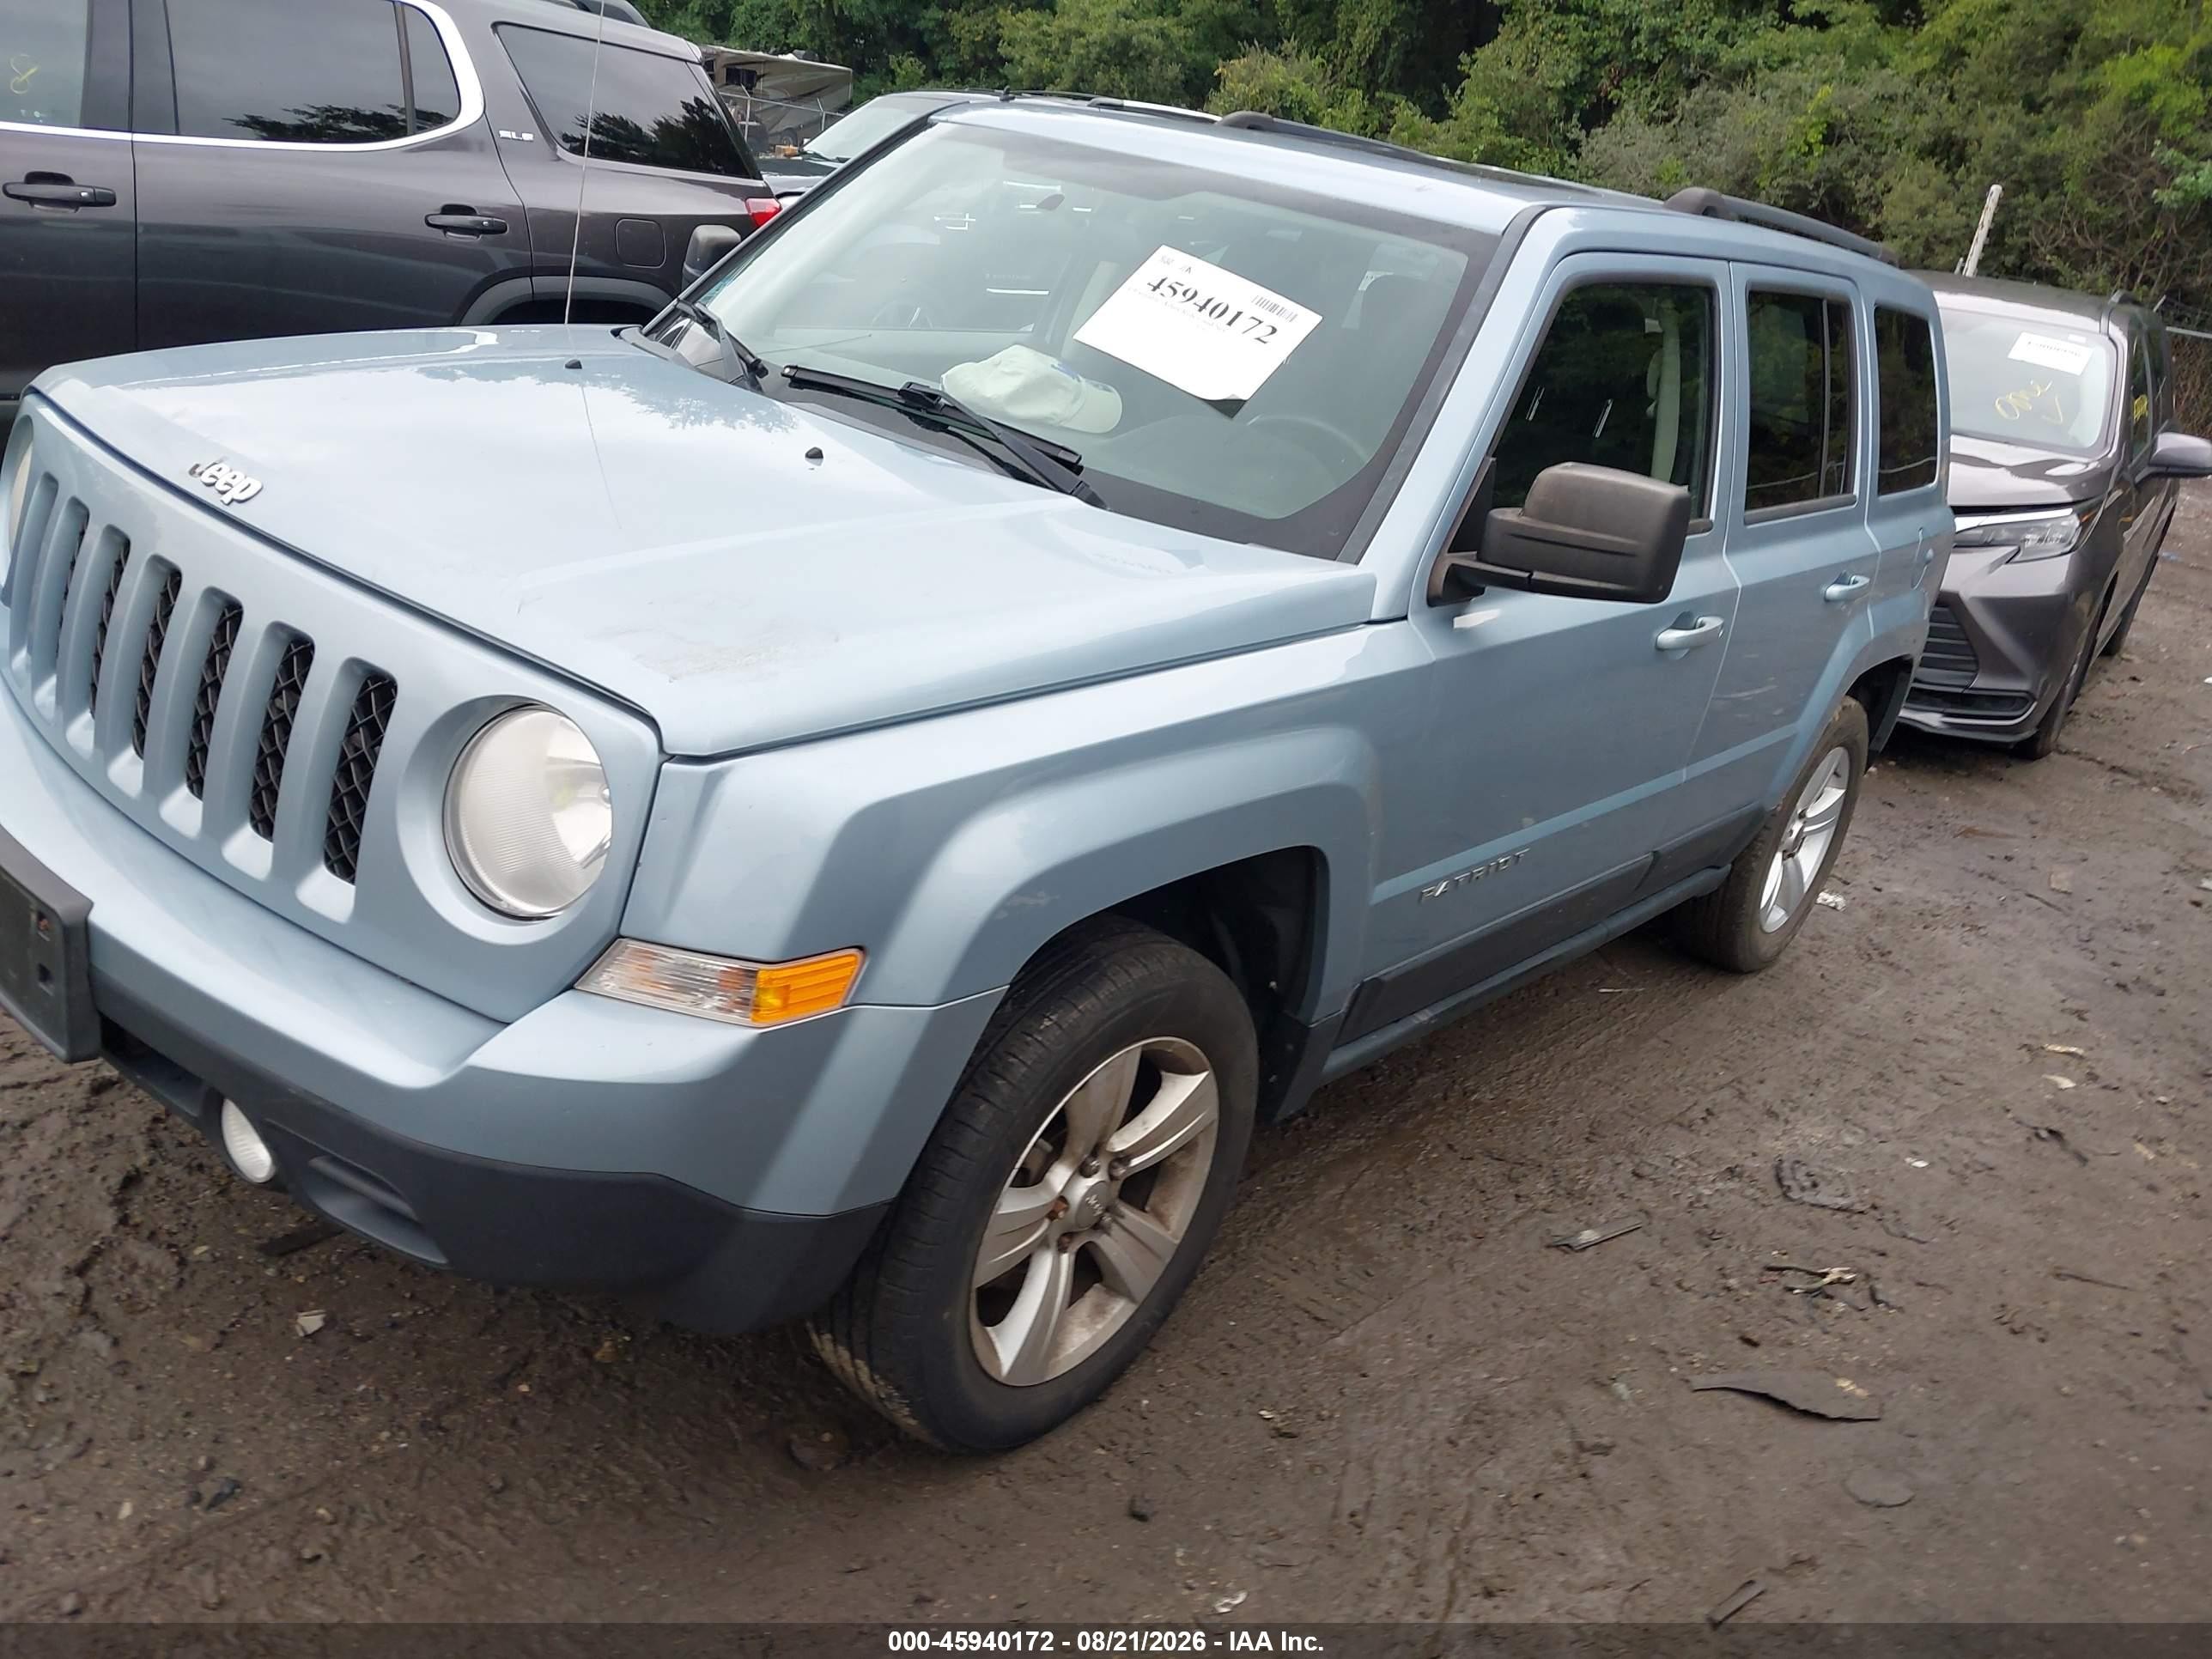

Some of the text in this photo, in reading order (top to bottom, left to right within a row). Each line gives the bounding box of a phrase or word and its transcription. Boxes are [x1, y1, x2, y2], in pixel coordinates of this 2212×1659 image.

[1146, 276, 1278, 344] 45940172
[188, 457, 264, 506] Jeep
[1418, 847, 1530, 903] PATRIOT
